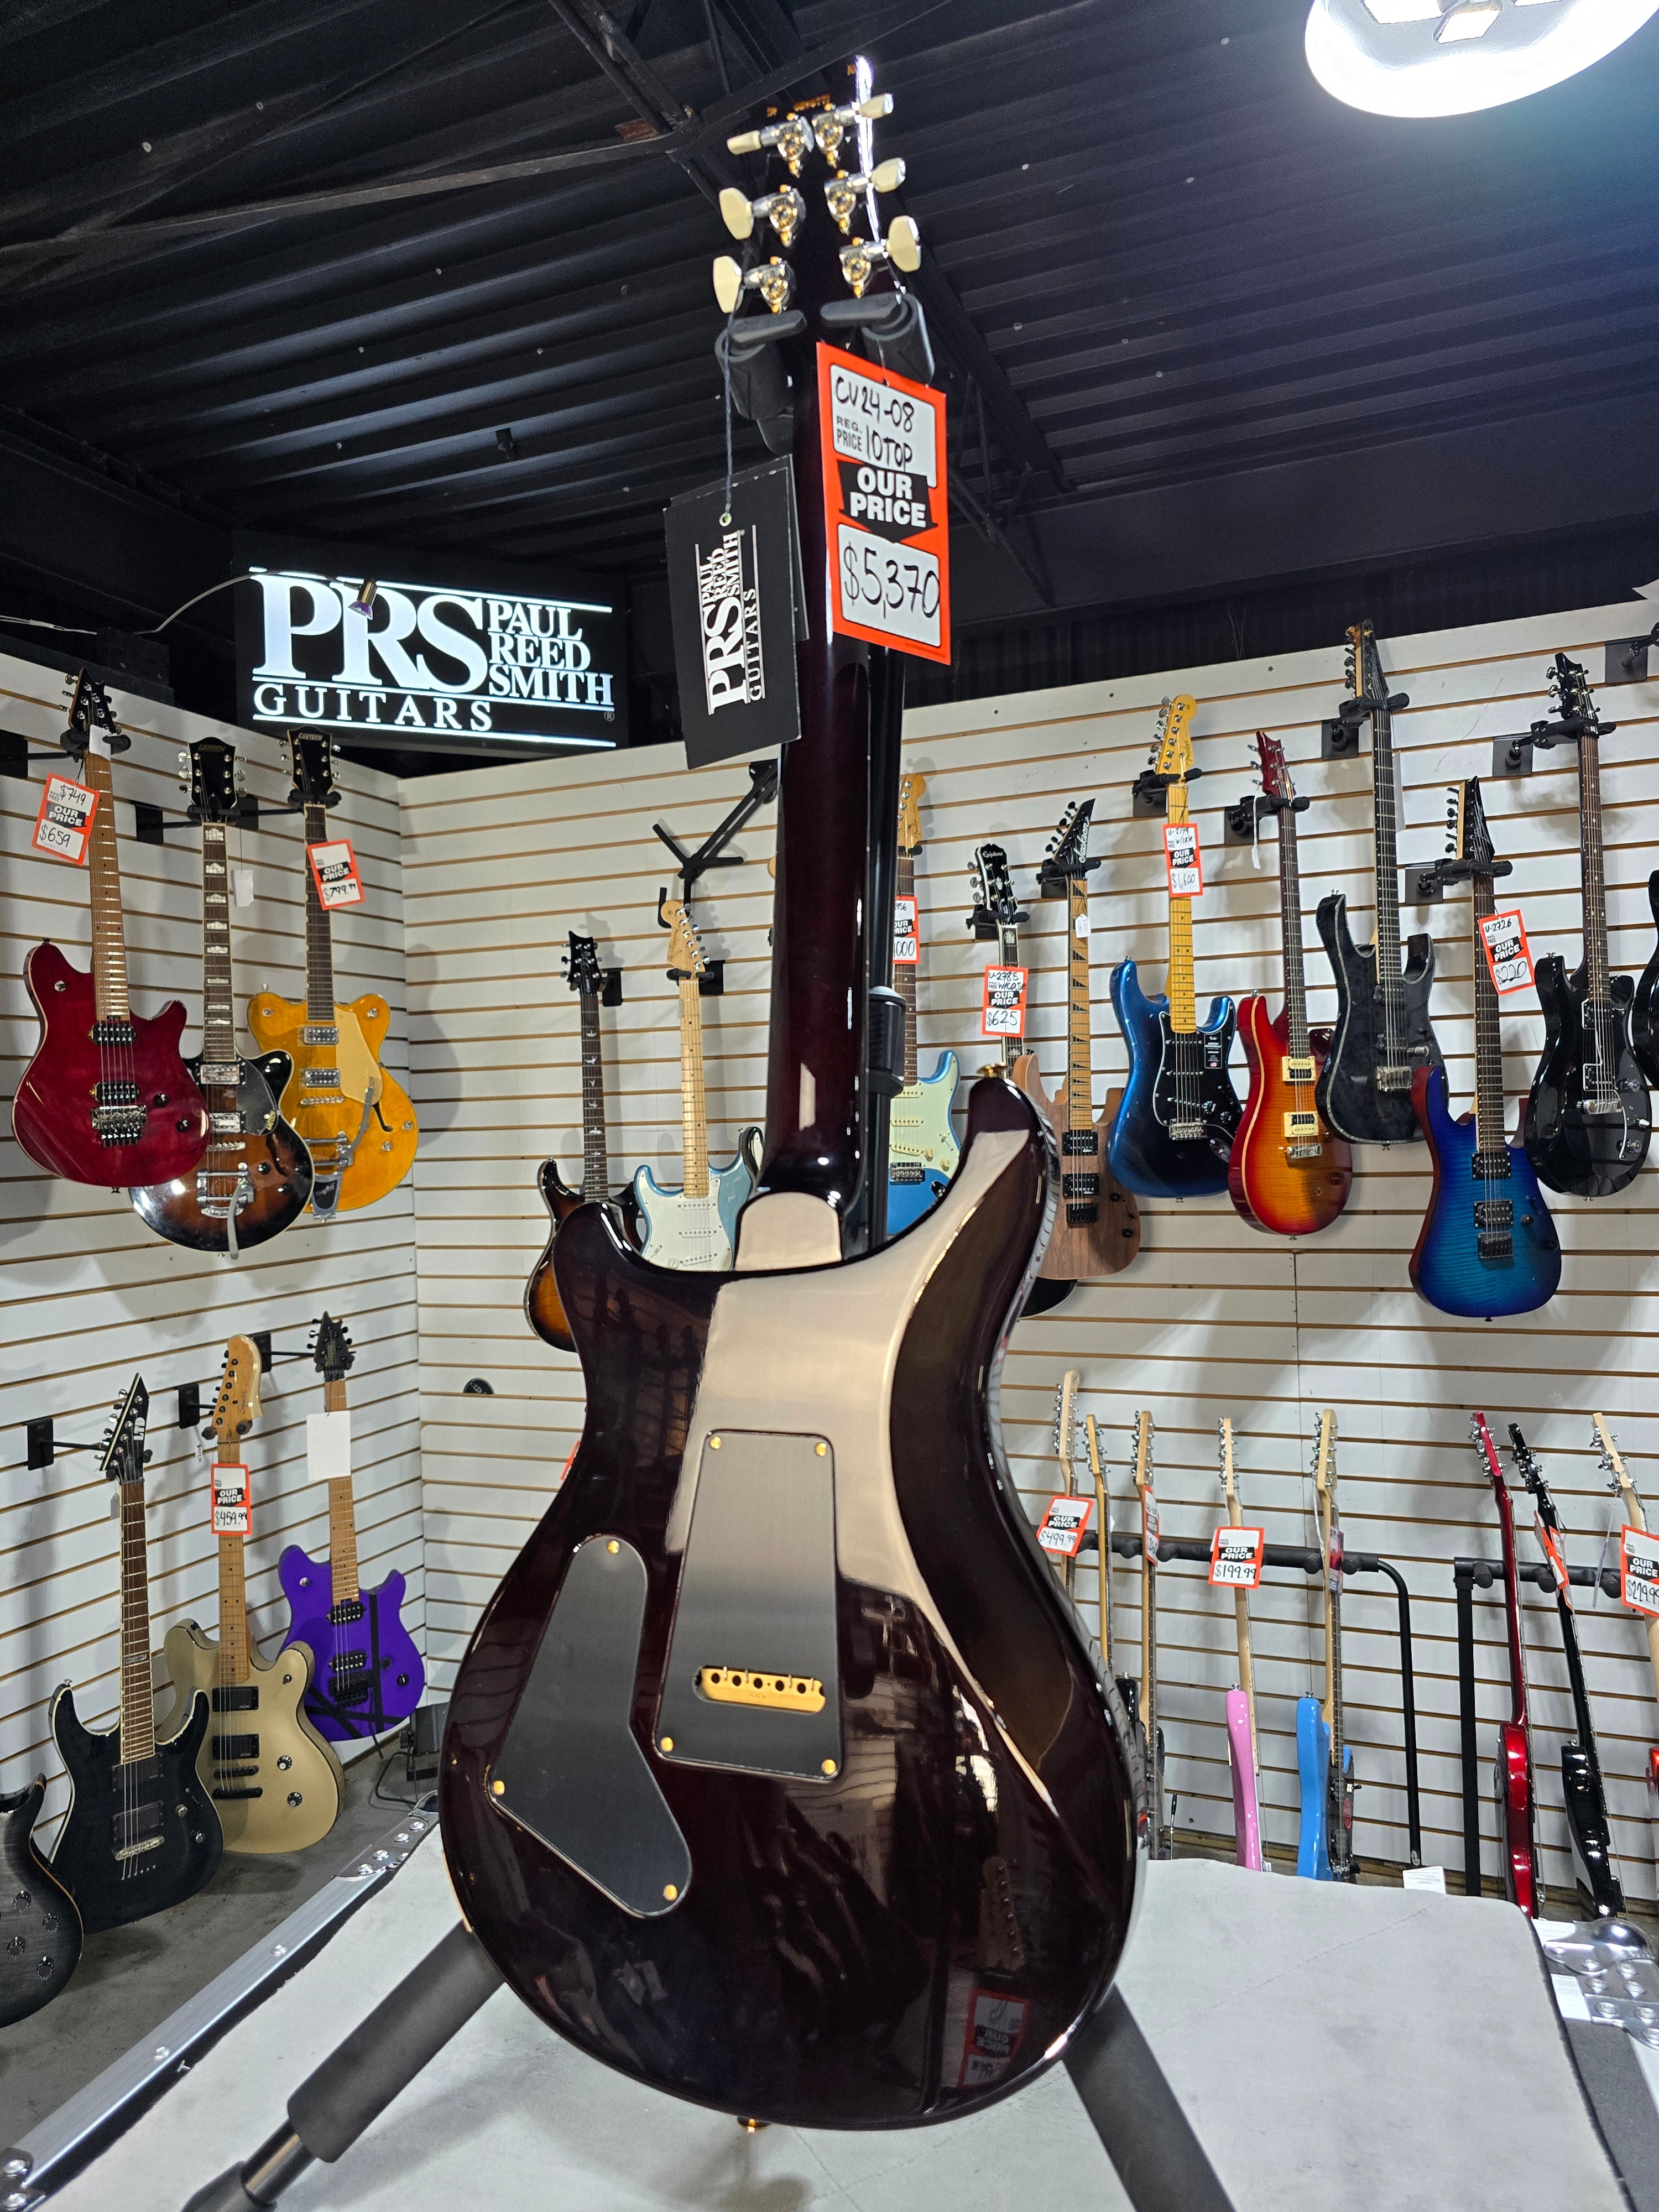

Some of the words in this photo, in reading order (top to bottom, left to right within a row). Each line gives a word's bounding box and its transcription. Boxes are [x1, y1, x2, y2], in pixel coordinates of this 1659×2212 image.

[836, 416, 863, 434] REG.
[837, 429, 862, 452] PRICE
[857, 467, 912, 500] OUR
[850, 492, 926, 528] PRICE
[711, 548, 727, 601] REED
[723, 531, 740, 597] SMITH
[700, 556, 716, 605] PAUL
[844, 541, 940, 619] $5,370
[487, 599, 583, 641] PAUL
[249, 575, 489, 693] PRS
[743, 588, 762, 701] GUITARS
[488, 632, 591, 672] REED
[703, 596, 748, 715] PRS
[488, 665, 614, 706] SMITH
[253, 683, 493, 732] GUITARS
[60, 784, 86, 805] $749
[49, 811, 83, 827] PRICE
[54, 806, 79, 817] OUR
[39, 824, 70, 847] $659
[1073, 816, 1089, 863] Jackson
[1172, 854, 1194, 866] PRICE
[1173, 849, 1190, 858] OUR
[322, 868, 349, 881] PRICE
[324, 864, 343, 874] OUR
[894, 926, 912, 935] RICE
[1494, 944, 1520, 962] PRICE
[1495, 940, 1514, 953] OUR
[1495, 961, 1527, 986] $220
[991, 997, 1018, 1005] PRICE
[987, 1010, 1018, 1026] $625
[217, 1495, 242, 1504] PRICE
[220, 1489, 238, 1497] OUR
[1214, 1564, 1256, 1579] $199.99
[1630, 1564, 1658, 1578] PRICE
[1632, 1557, 1653, 1569] OUR
